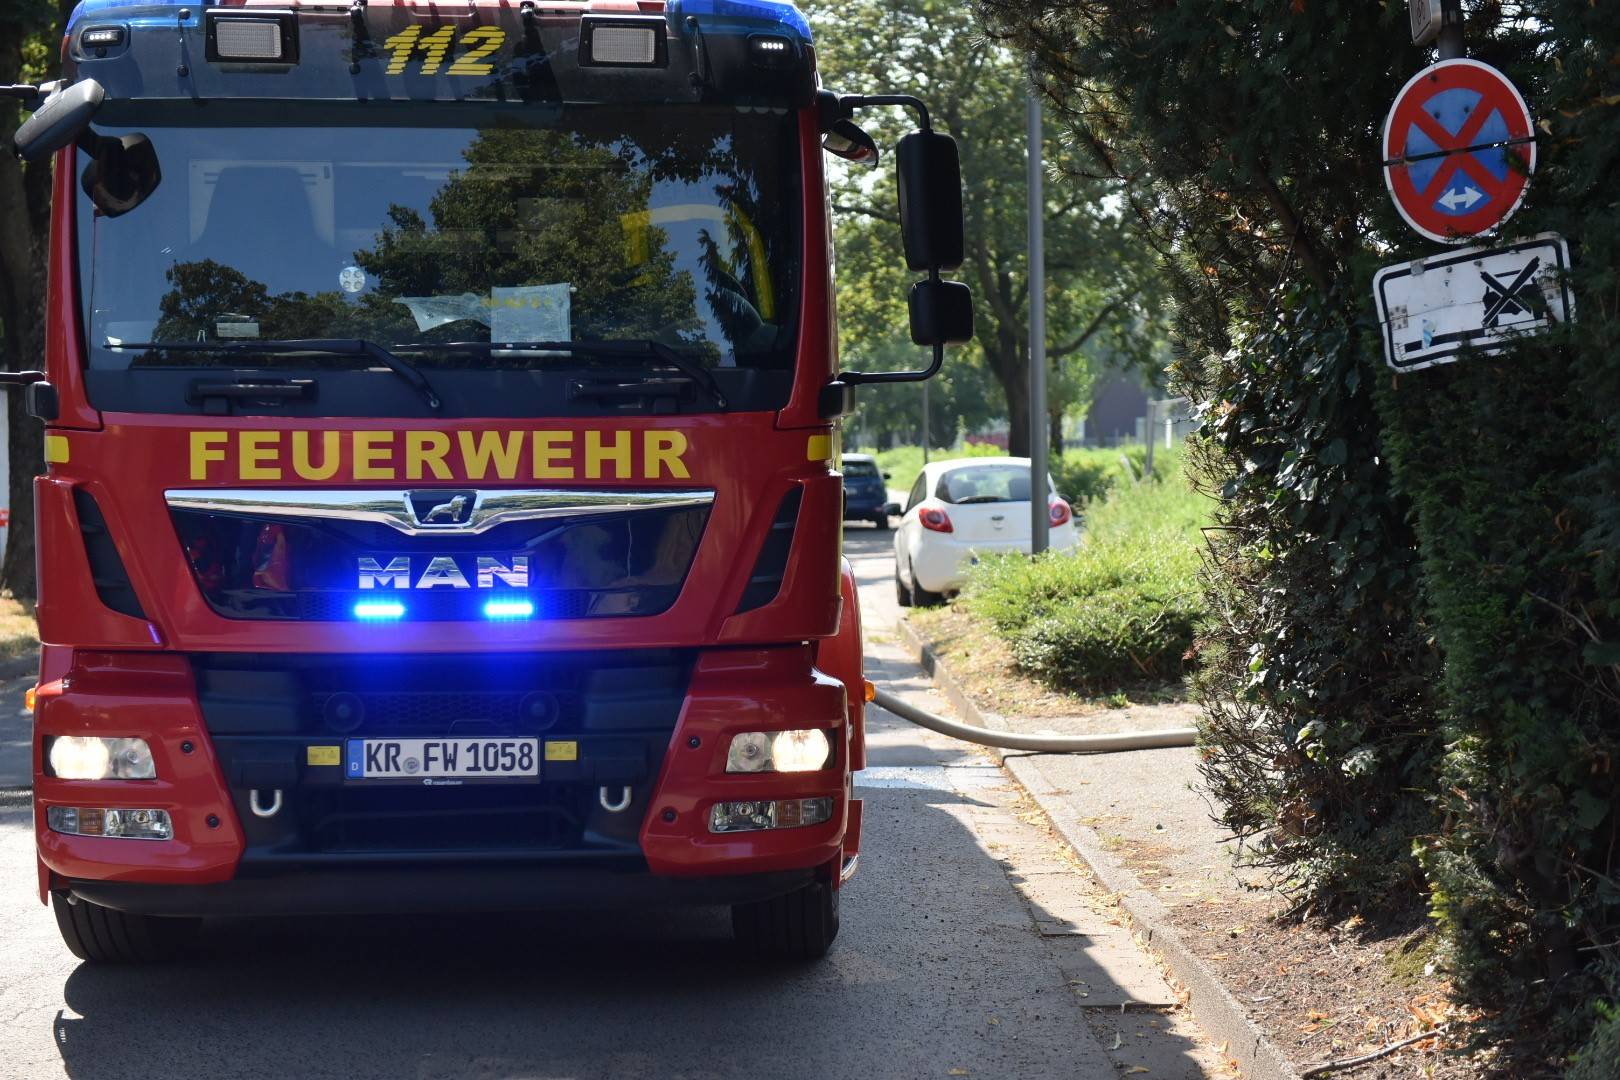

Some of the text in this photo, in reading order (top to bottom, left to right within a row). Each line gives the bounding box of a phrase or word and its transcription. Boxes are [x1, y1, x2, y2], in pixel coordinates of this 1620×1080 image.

[384, 25, 505, 75] 112
[189, 430, 691, 480] FEUERWEHR
[359, 557, 528, 589] MAN
[366, 742, 533, 772] KR FW 1058
